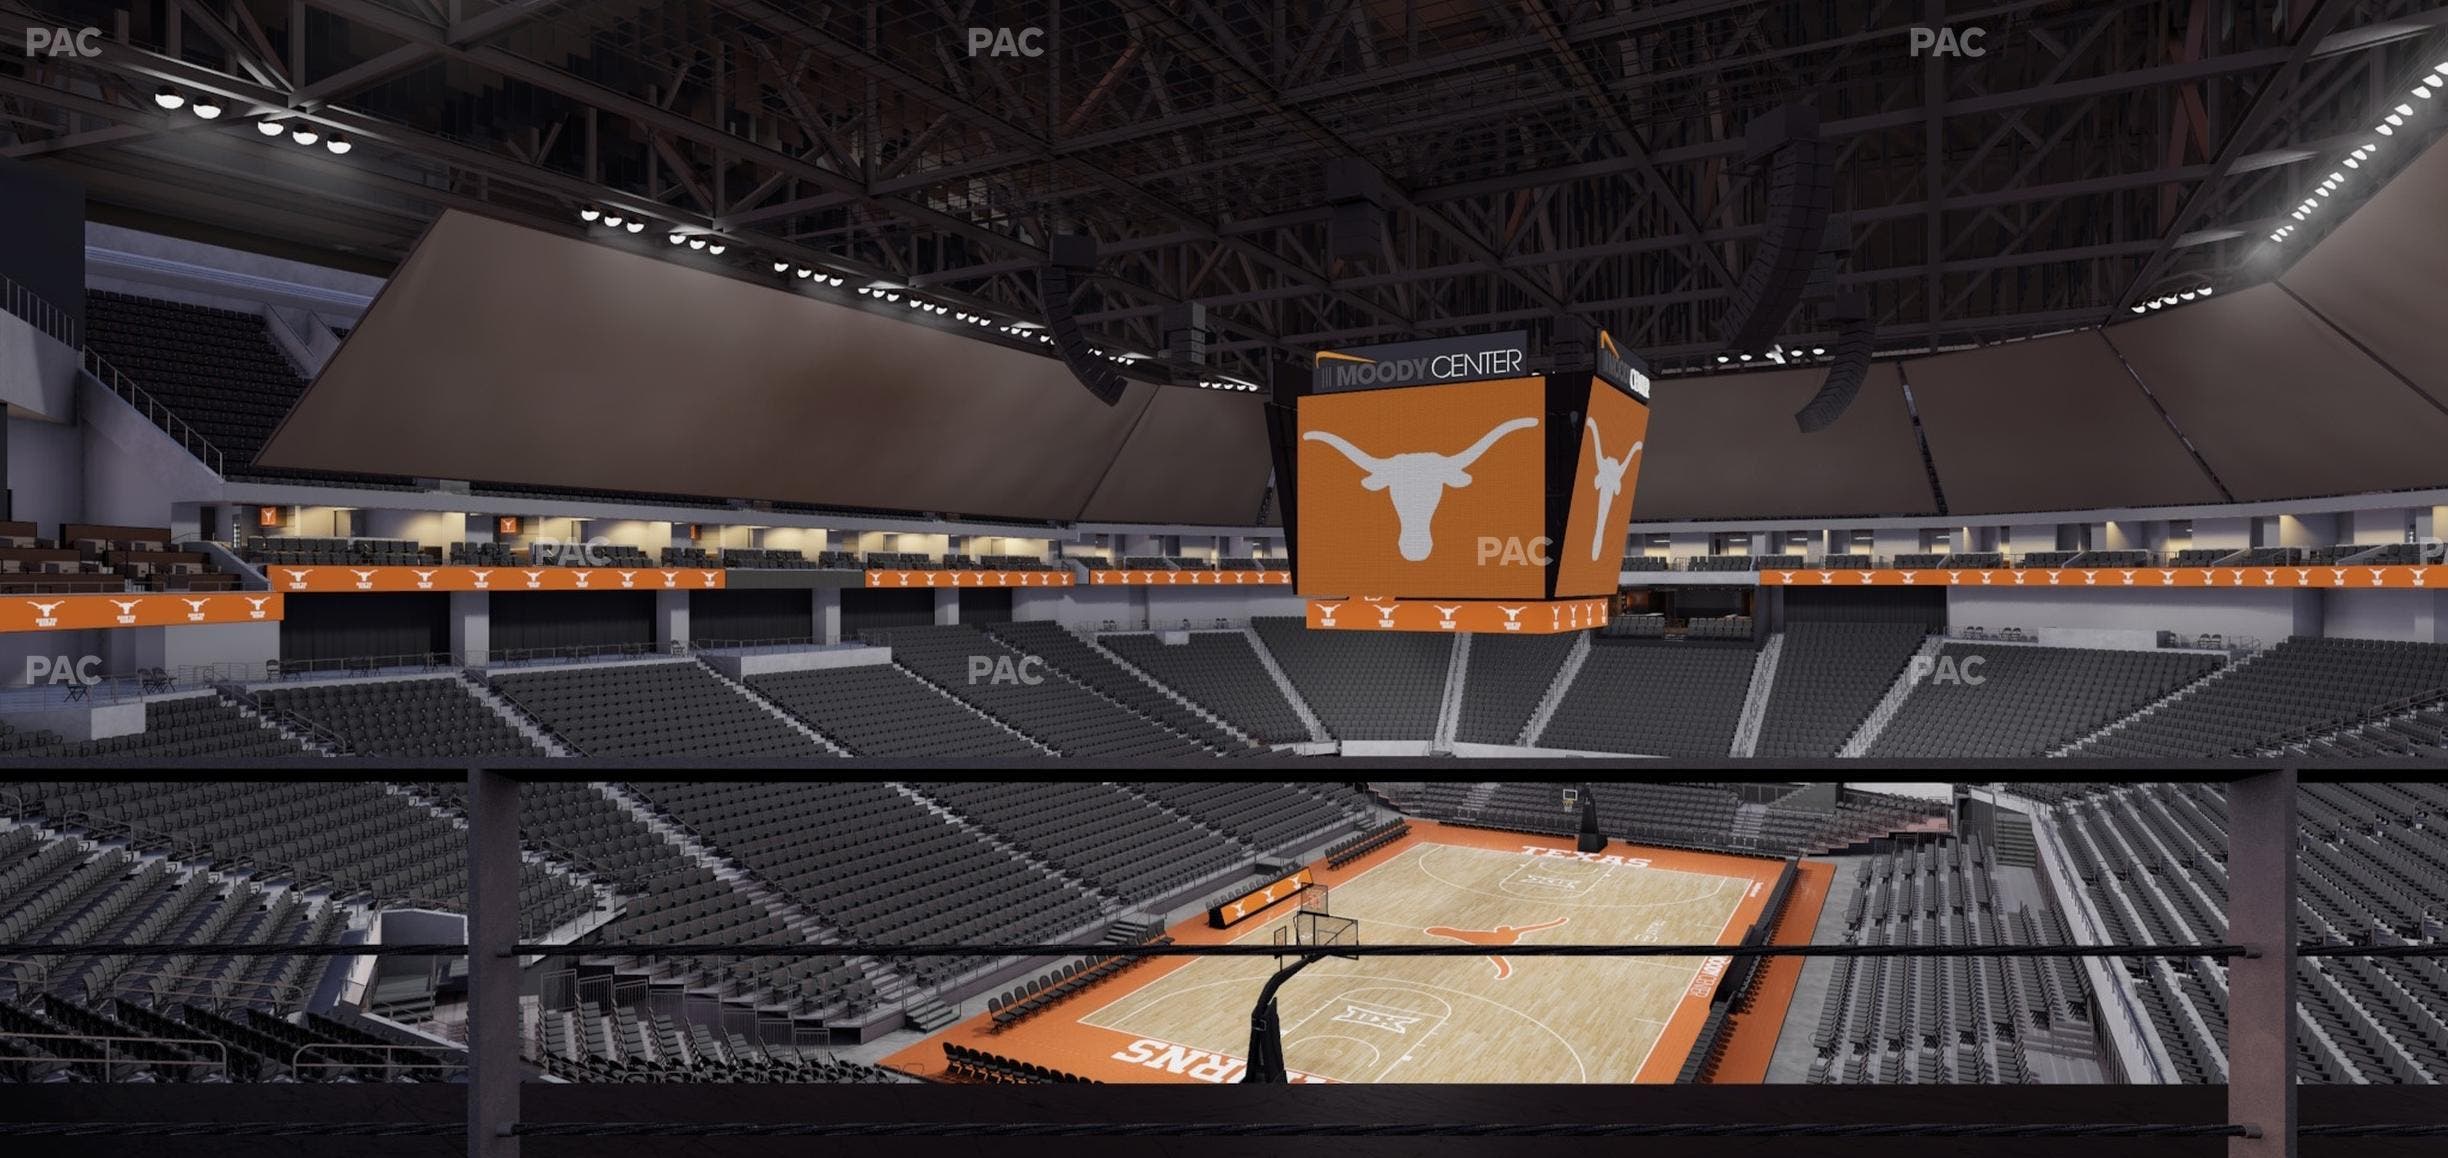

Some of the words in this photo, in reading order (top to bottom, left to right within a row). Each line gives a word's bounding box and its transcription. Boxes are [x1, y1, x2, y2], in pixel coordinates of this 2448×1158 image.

[1336, 357, 1430, 387] MOODY
[1431, 348, 1523, 379] CENTER
[1520, 845, 1653, 869] TEXAS
